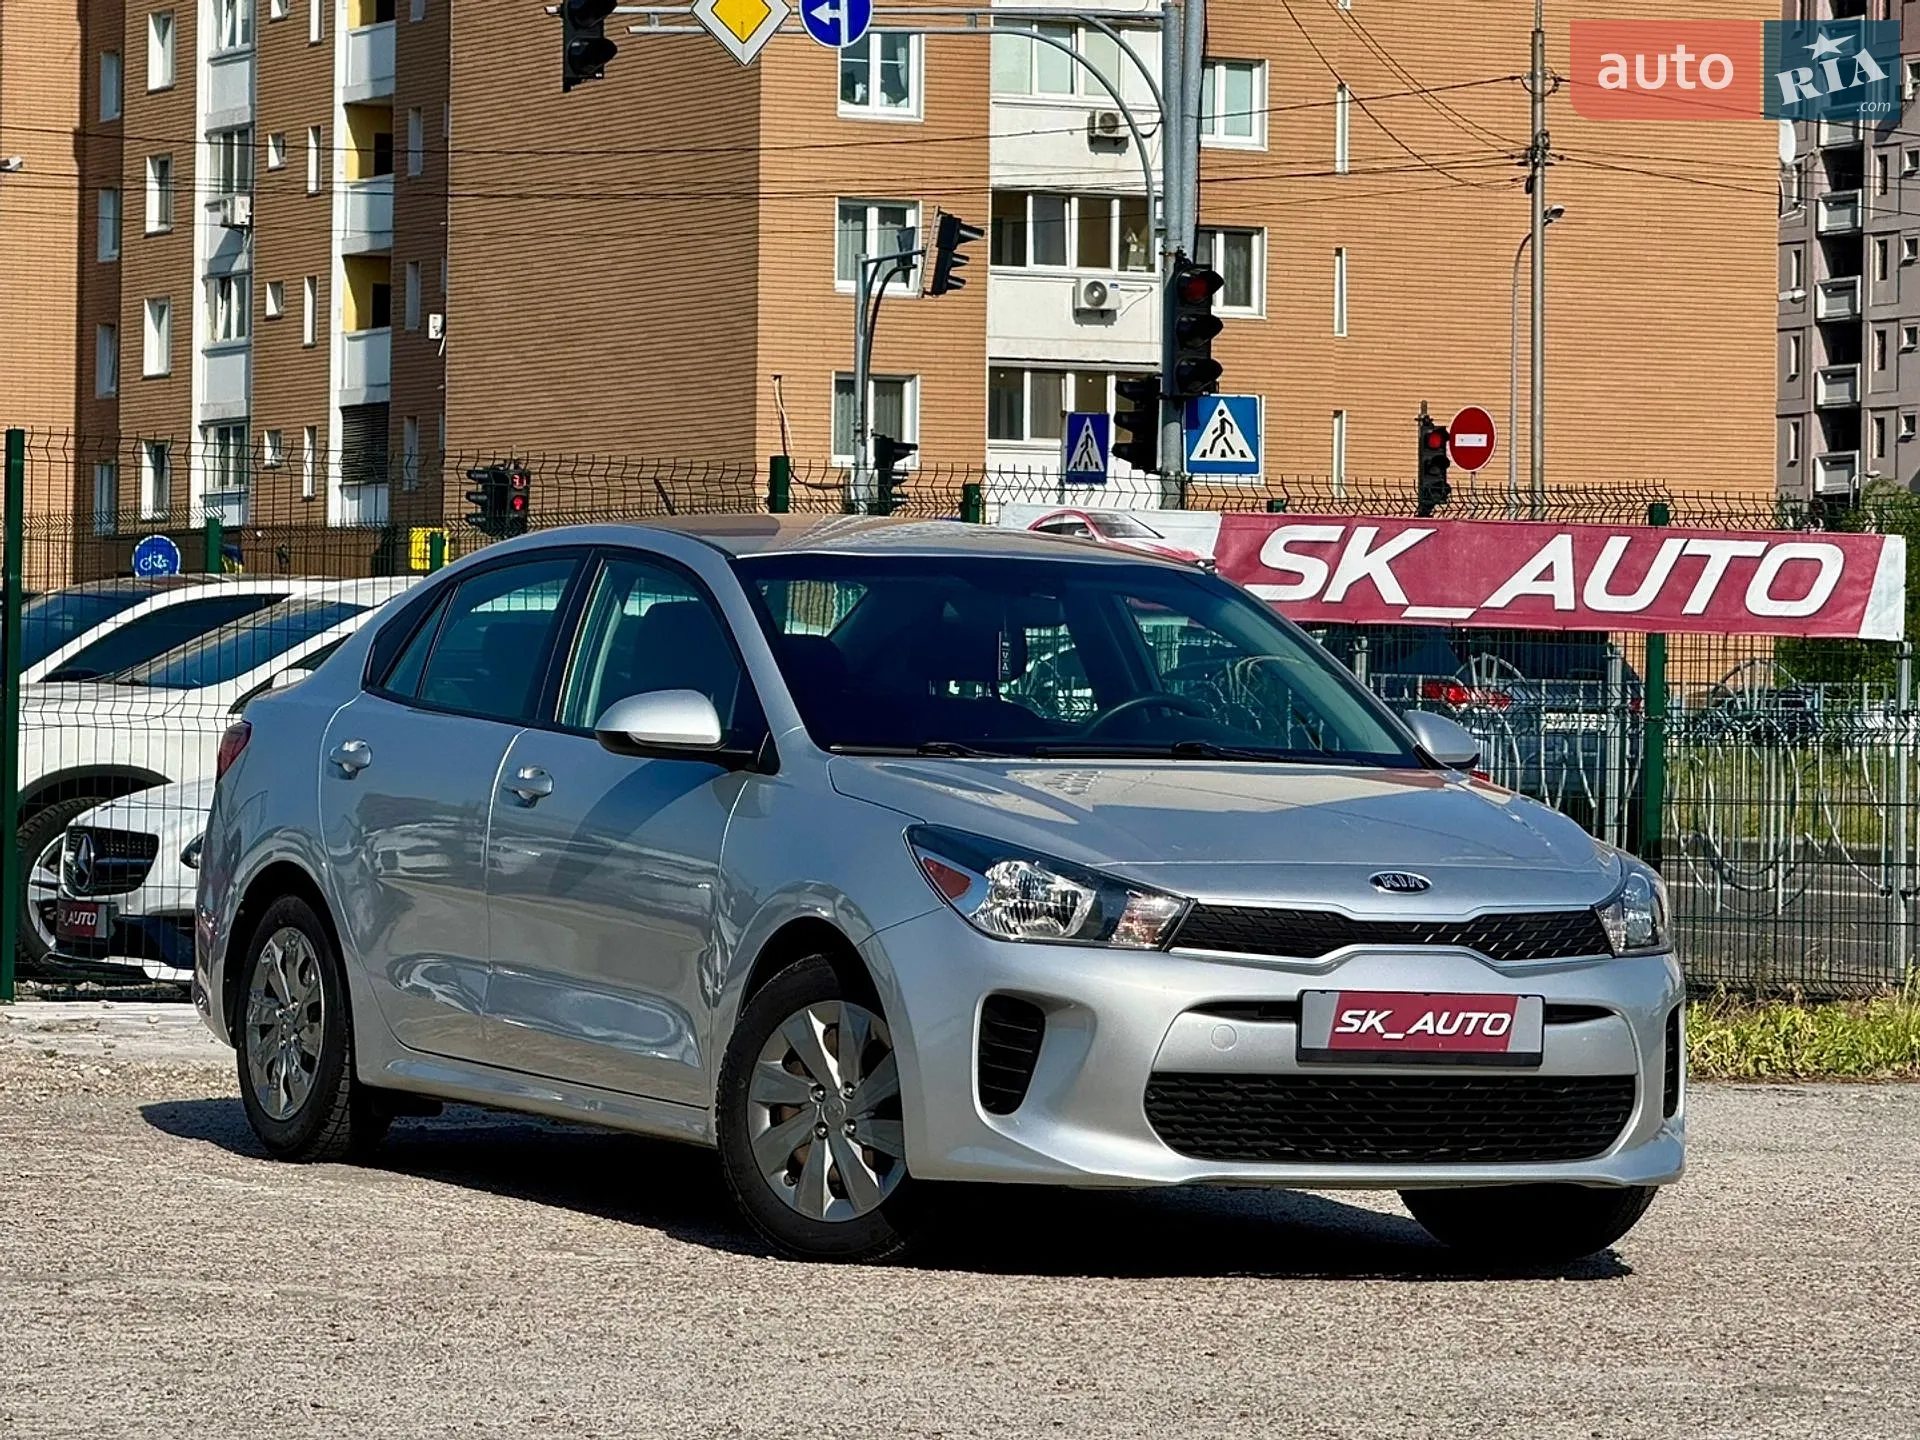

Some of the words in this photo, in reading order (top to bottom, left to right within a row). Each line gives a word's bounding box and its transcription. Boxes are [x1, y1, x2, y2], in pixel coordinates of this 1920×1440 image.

[1243, 524, 1845, 620] SK_AUTO
[1378, 874, 1425, 889] KIA
[1334, 1009, 1512, 1039] SK_AUTO
